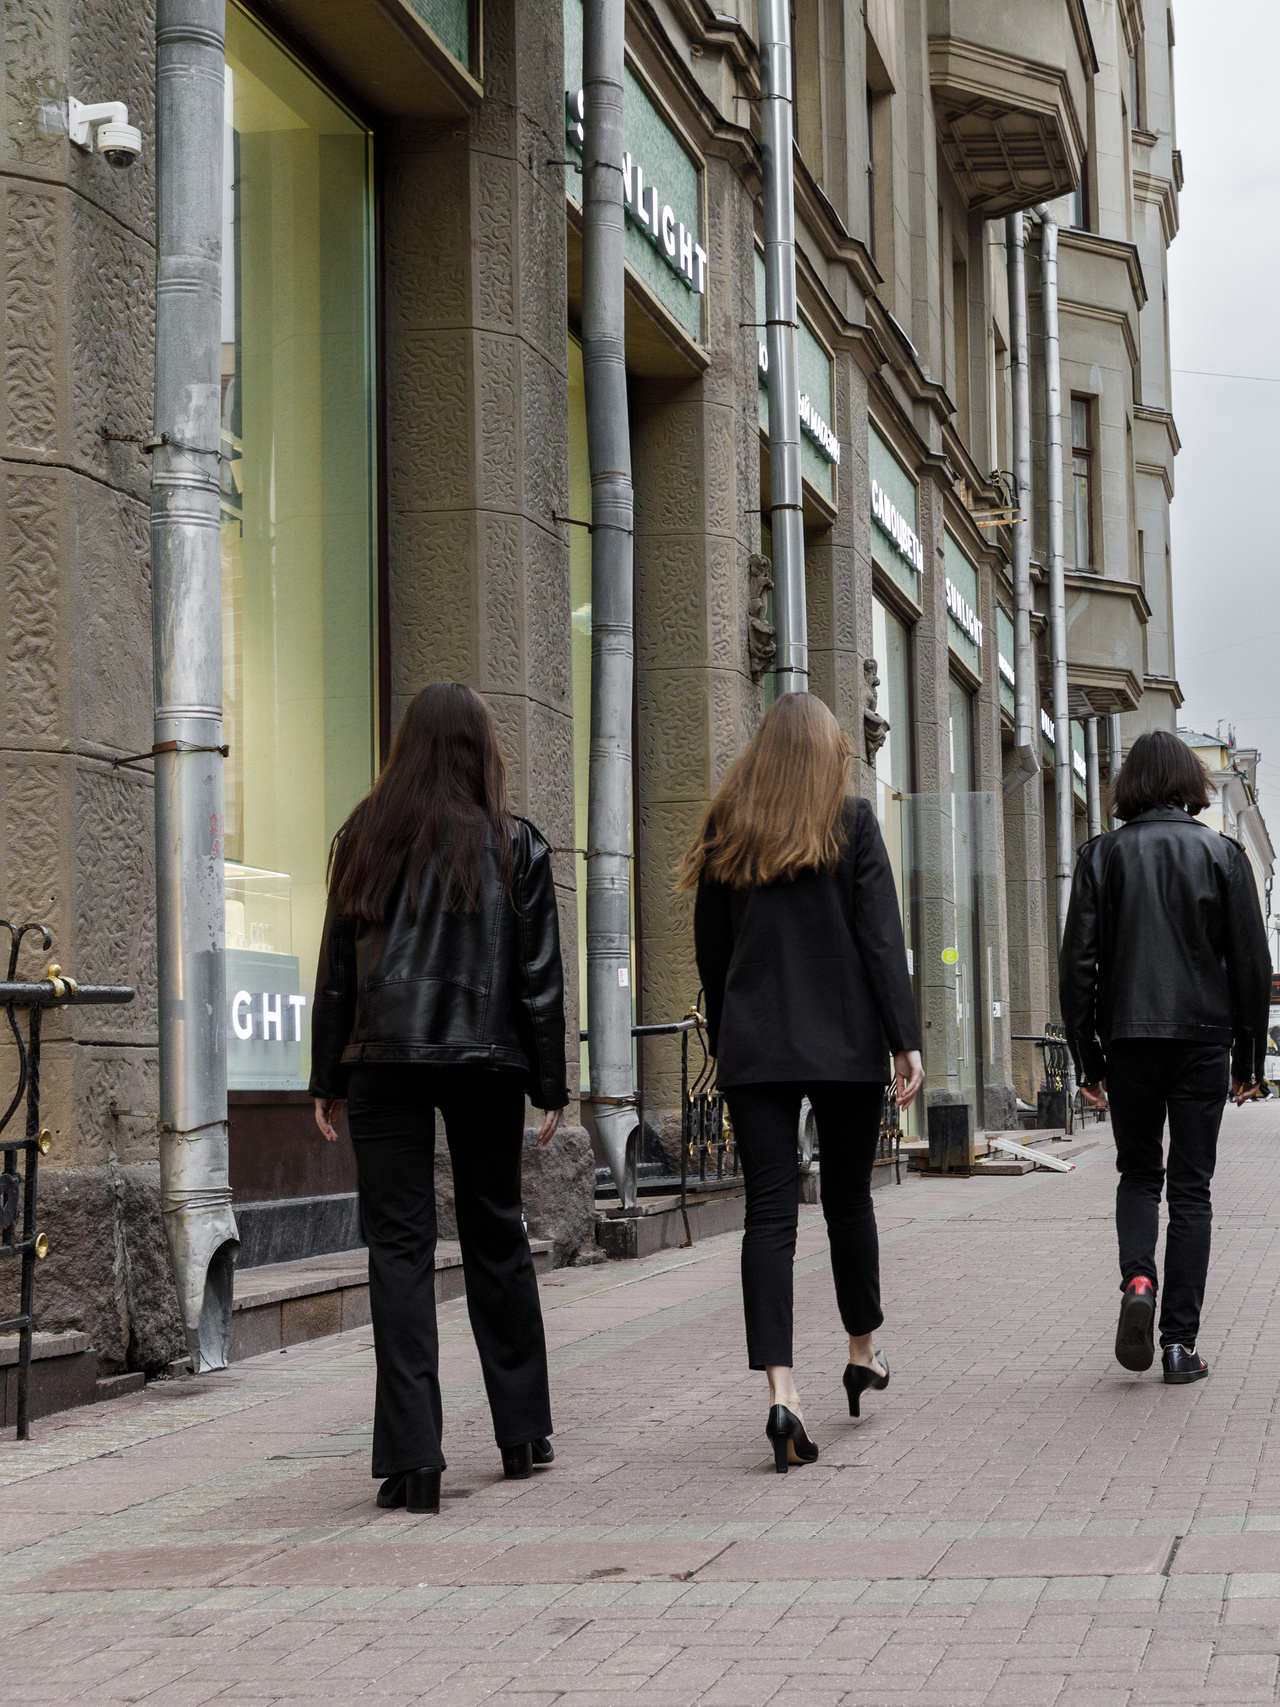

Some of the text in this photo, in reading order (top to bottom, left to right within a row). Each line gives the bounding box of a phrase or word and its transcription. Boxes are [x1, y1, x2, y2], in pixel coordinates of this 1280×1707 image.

[572, 89, 707, 294] NLIGHT
[871, 479, 924, 574] САМОЦВЕТЫ
[945, 577, 983, 648] SUNLIGHT
